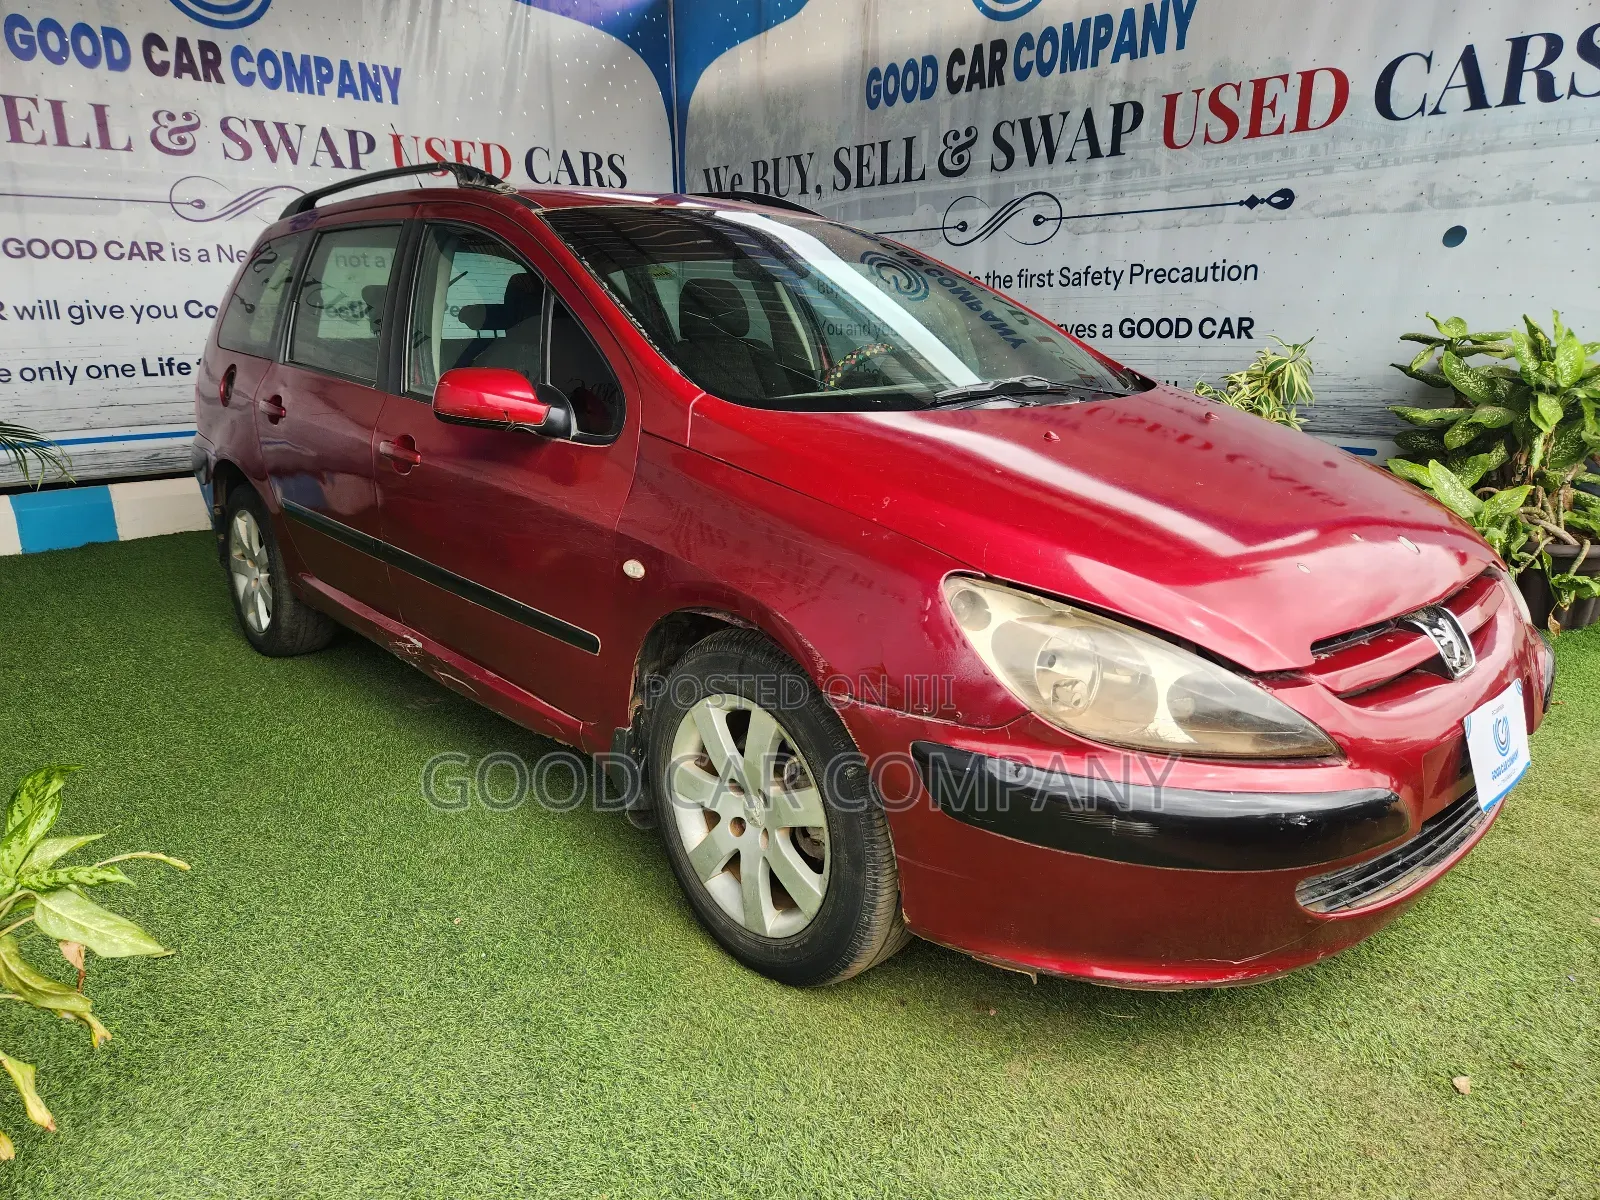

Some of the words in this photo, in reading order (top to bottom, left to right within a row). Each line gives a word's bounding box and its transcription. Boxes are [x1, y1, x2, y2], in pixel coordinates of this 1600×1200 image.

[4, 13, 131, 72] GOOD
[143, 32, 225, 84] CAR
[231, 44, 401, 105] COMPANY
[866, 55, 938, 110] GOOD
[947, 38, 1007, 94] CAR
[1013, 0, 1197, 82] COMPANY
[703, 165, 743, 192] We
[751, 152, 822, 200] BUY,
[833, 136, 926, 191] SELL
[938, 126, 978, 177] &
[990, 100, 1143, 173] SWAP
[1162, 67, 1349, 150] USED
[1375, 23, 1600, 121] CARS
[150, 110, 200, 156] &
[220, 115, 376, 170] SWAP
[388, 133, 511, 180] USED
[525, 147, 627, 189] CARS
[2, 237, 97, 260] GOOD
[104, 241, 165, 262] CAR
[172, 244, 190, 262] is
[198, 248, 211, 262] a
[216, 244, 248, 263] Ne
[985, 270, 1013, 289] the
[1017, 269, 1054, 288] first
[1059, 265, 1124, 290] Safety
[1129, 259, 1258, 285] Precaution
[13, 299, 60, 320] will
[67, 299, 125, 326] give
[130, 304, 178, 324] you
[184, 299, 218, 319] Co
[1102, 324, 1112, 338] a
[1119, 317, 1192, 340] GOOD
[1198, 316, 1255, 340] CAR
[20, 360, 78, 385] only
[86, 363, 136, 379] one
[141, 356, 192, 377] Life
